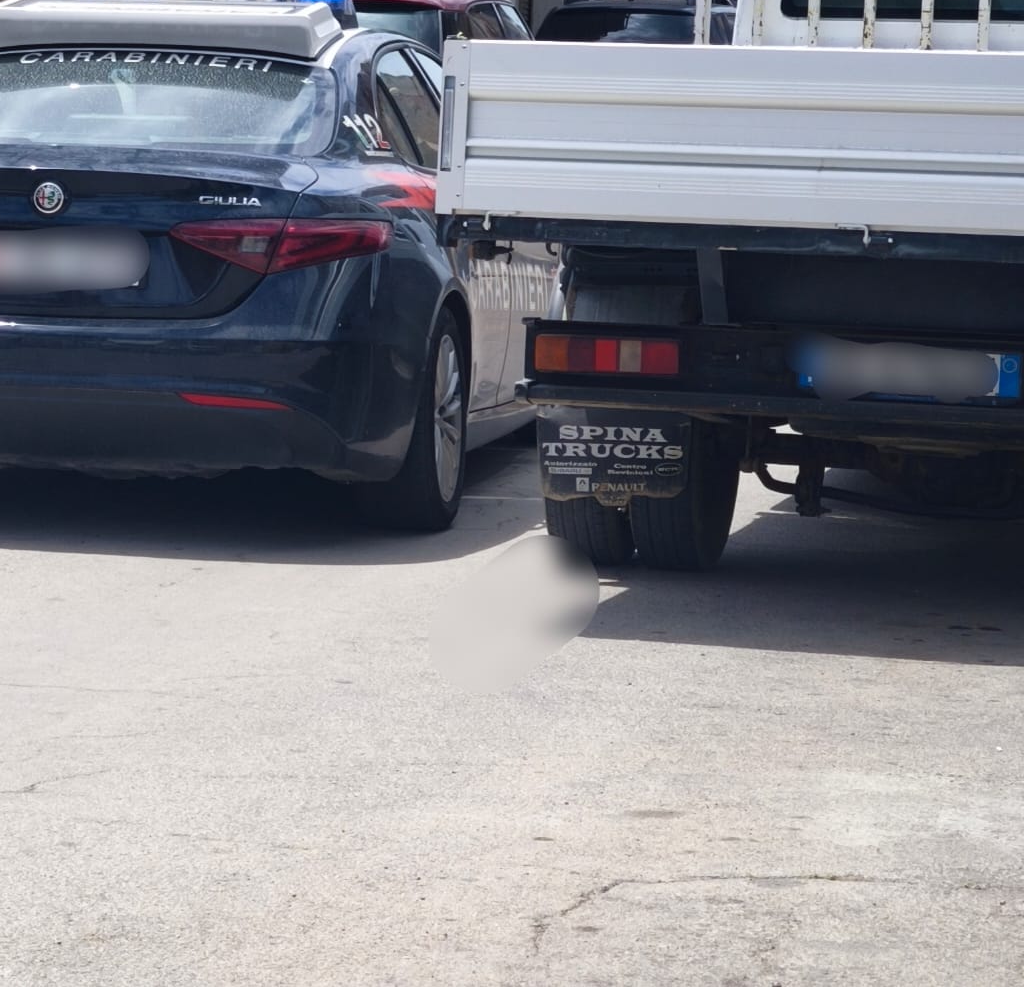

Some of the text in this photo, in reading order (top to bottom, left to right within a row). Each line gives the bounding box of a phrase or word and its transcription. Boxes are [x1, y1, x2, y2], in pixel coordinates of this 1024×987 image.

[19, 51, 273, 73] CARABINIERI
[342, 113, 392, 150] 112
[199, 196, 262, 207] GIULIA
[559, 424, 668, 443] SPINA
[542, 442, 684, 460] TRUCKS
